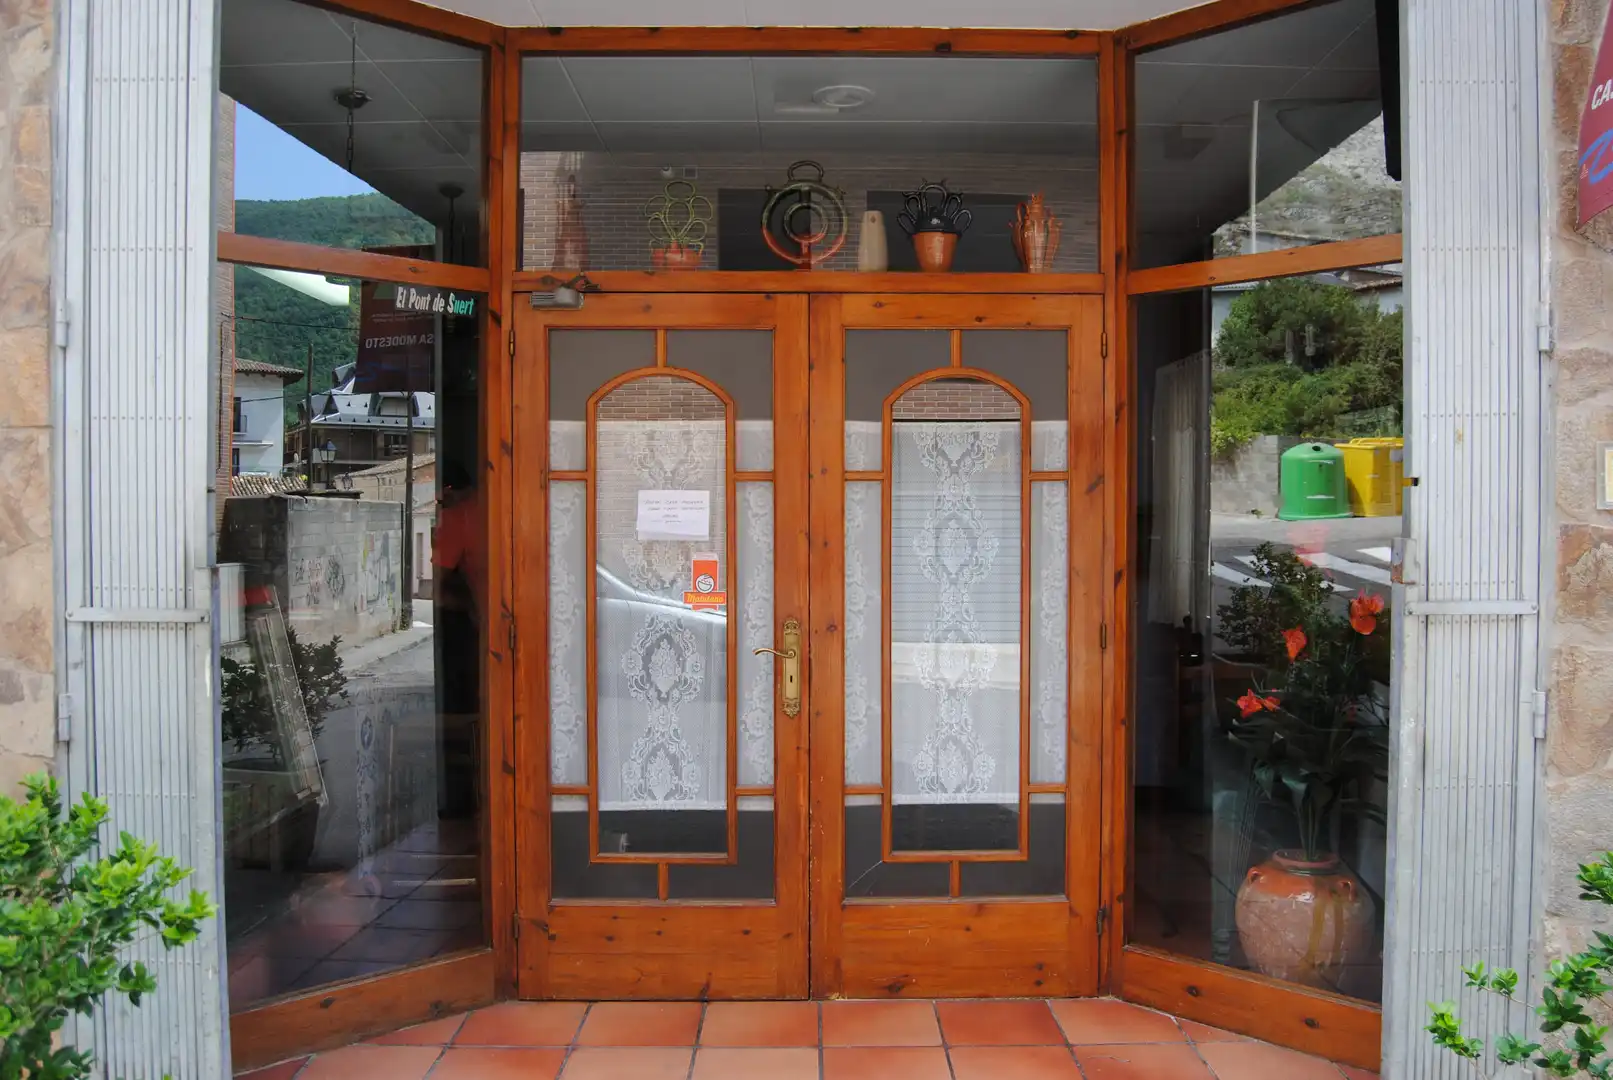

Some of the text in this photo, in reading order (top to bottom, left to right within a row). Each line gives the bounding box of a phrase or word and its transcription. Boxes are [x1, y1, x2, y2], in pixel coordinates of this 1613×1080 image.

[1591, 78, 1613, 110] CA
[395, 286, 475, 315] El Pont de Suert
[686, 593, 723, 603] Matutano
